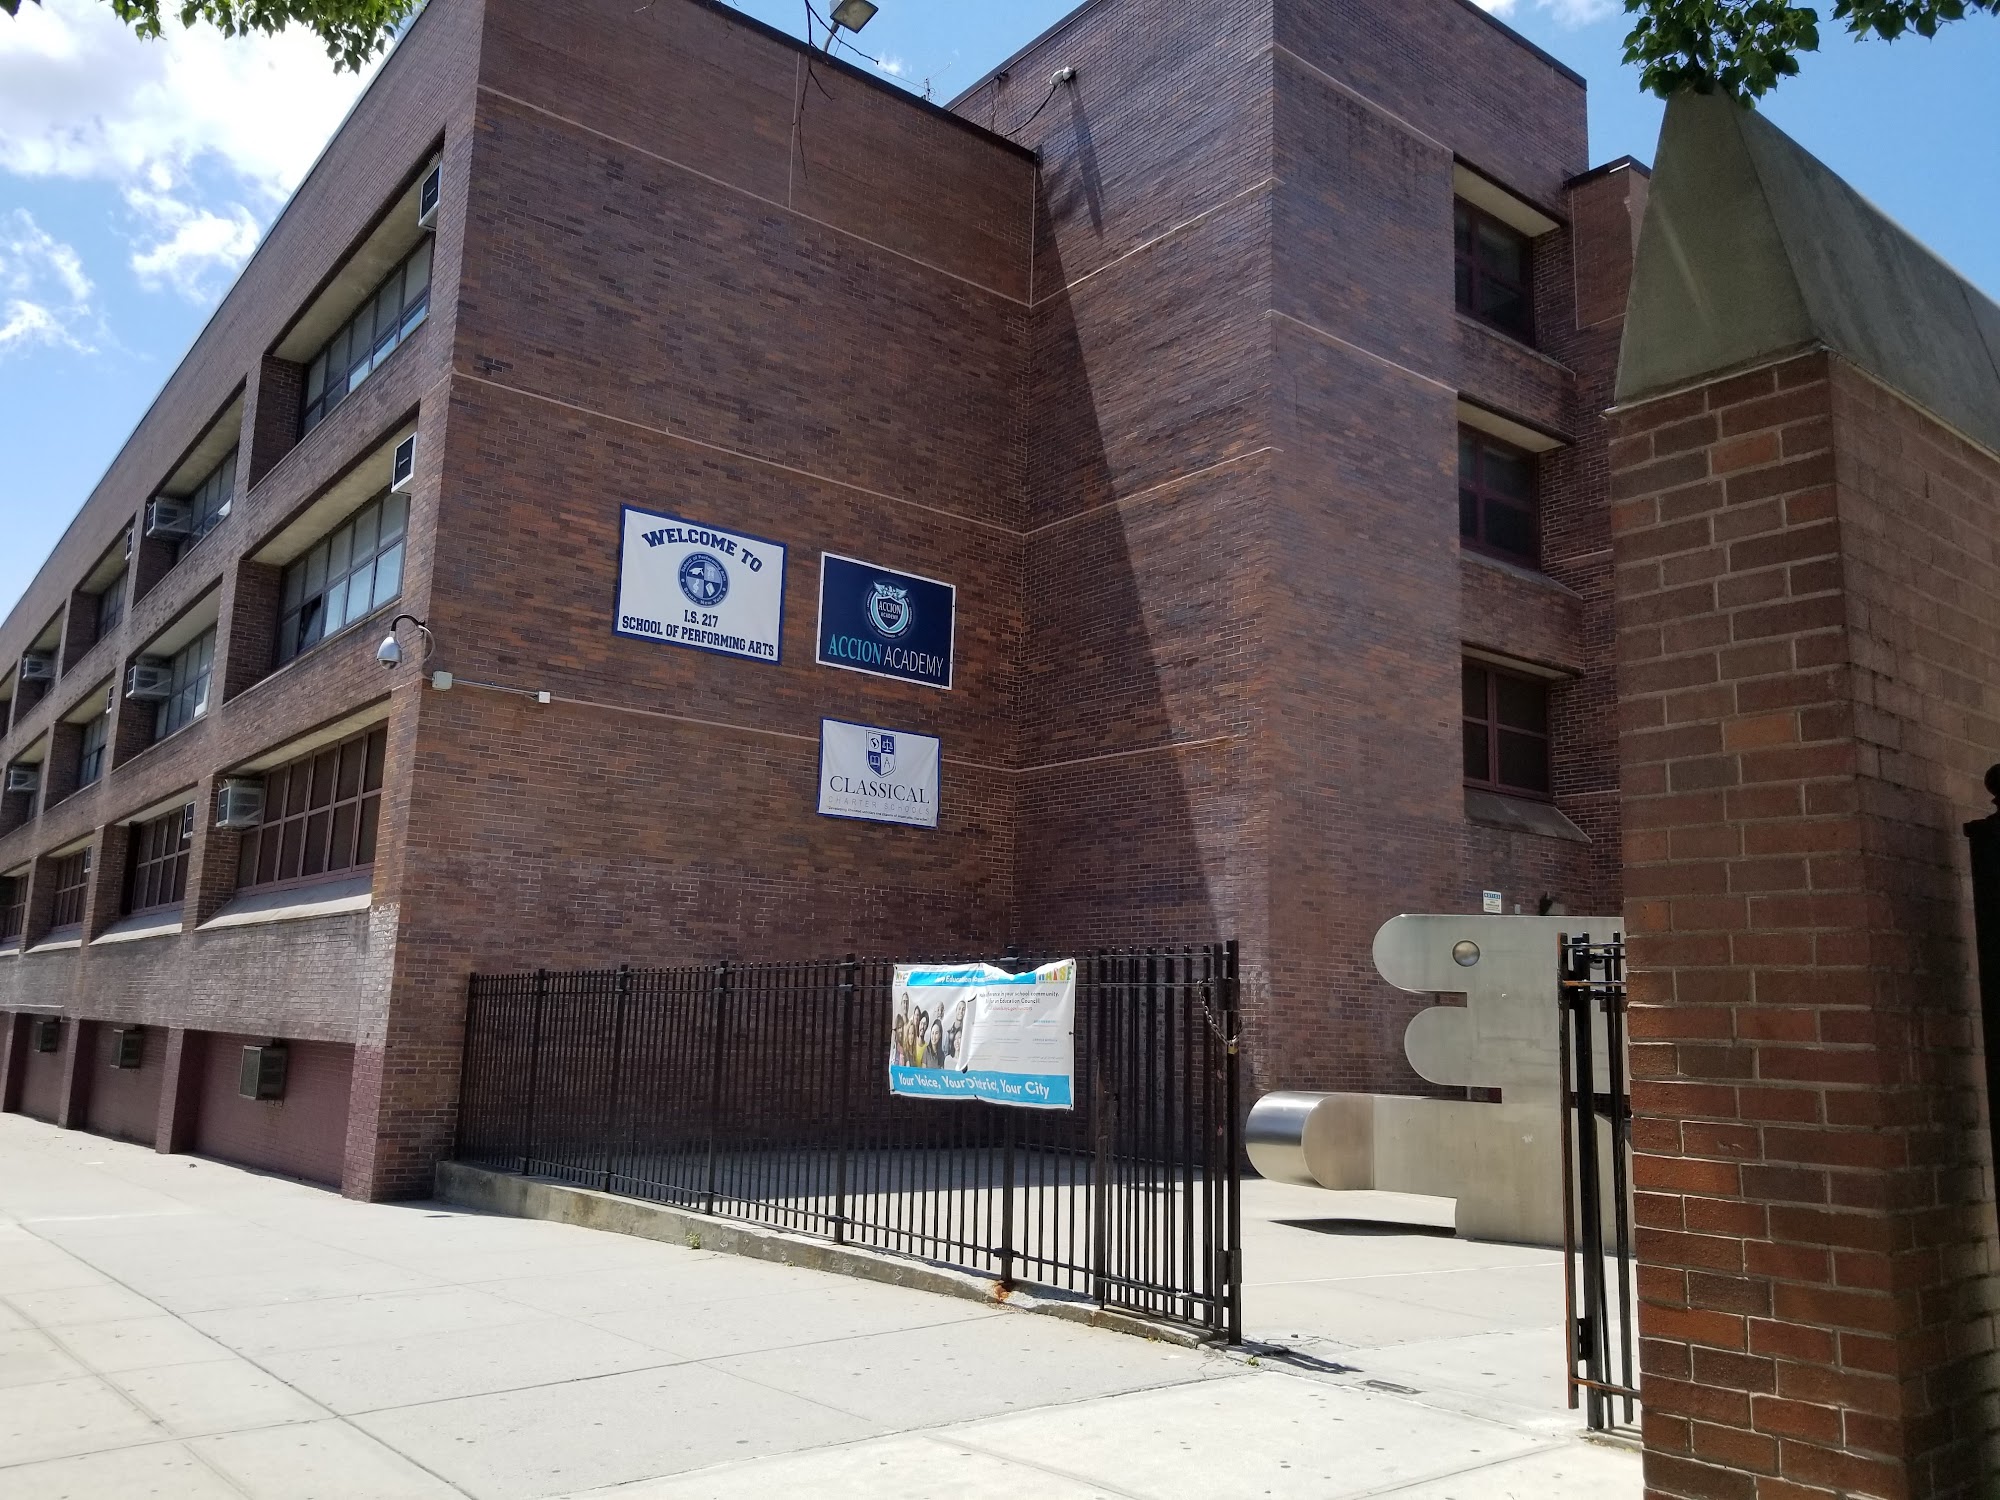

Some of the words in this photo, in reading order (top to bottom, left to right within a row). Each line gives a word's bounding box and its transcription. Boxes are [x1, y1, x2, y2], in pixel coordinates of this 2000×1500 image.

[642, 528, 738, 556] WELCOME
[741, 548, 763, 572] TO
[684, 610, 699, 625] I.S.
[702, 613, 718, 628] 217
[878, 600, 902, 614] ACCION
[880, 612, 899, 620] ACADEMY
[622, 615, 663, 635] SCHOOL
[666, 624, 679, 638] OF
[681, 626, 746, 651] PERFORMING
[748, 641, 774, 656] ARTS
[828, 634, 882, 665] ACCION
[884, 646, 944, 677] ACADEMY
[830, 775, 930, 804] CLASSICAL
[828, 796, 877, 808] CHARTER
[884, 802, 930, 815] SCHOOLS
[898, 1073, 914, 1086] Your
[915, 1074, 941, 1089] Voice,
[941, 1076, 965, 1088] Your
[1000, 1079, 1022, 1094] Your
[1024, 1081, 1050, 1100] City
